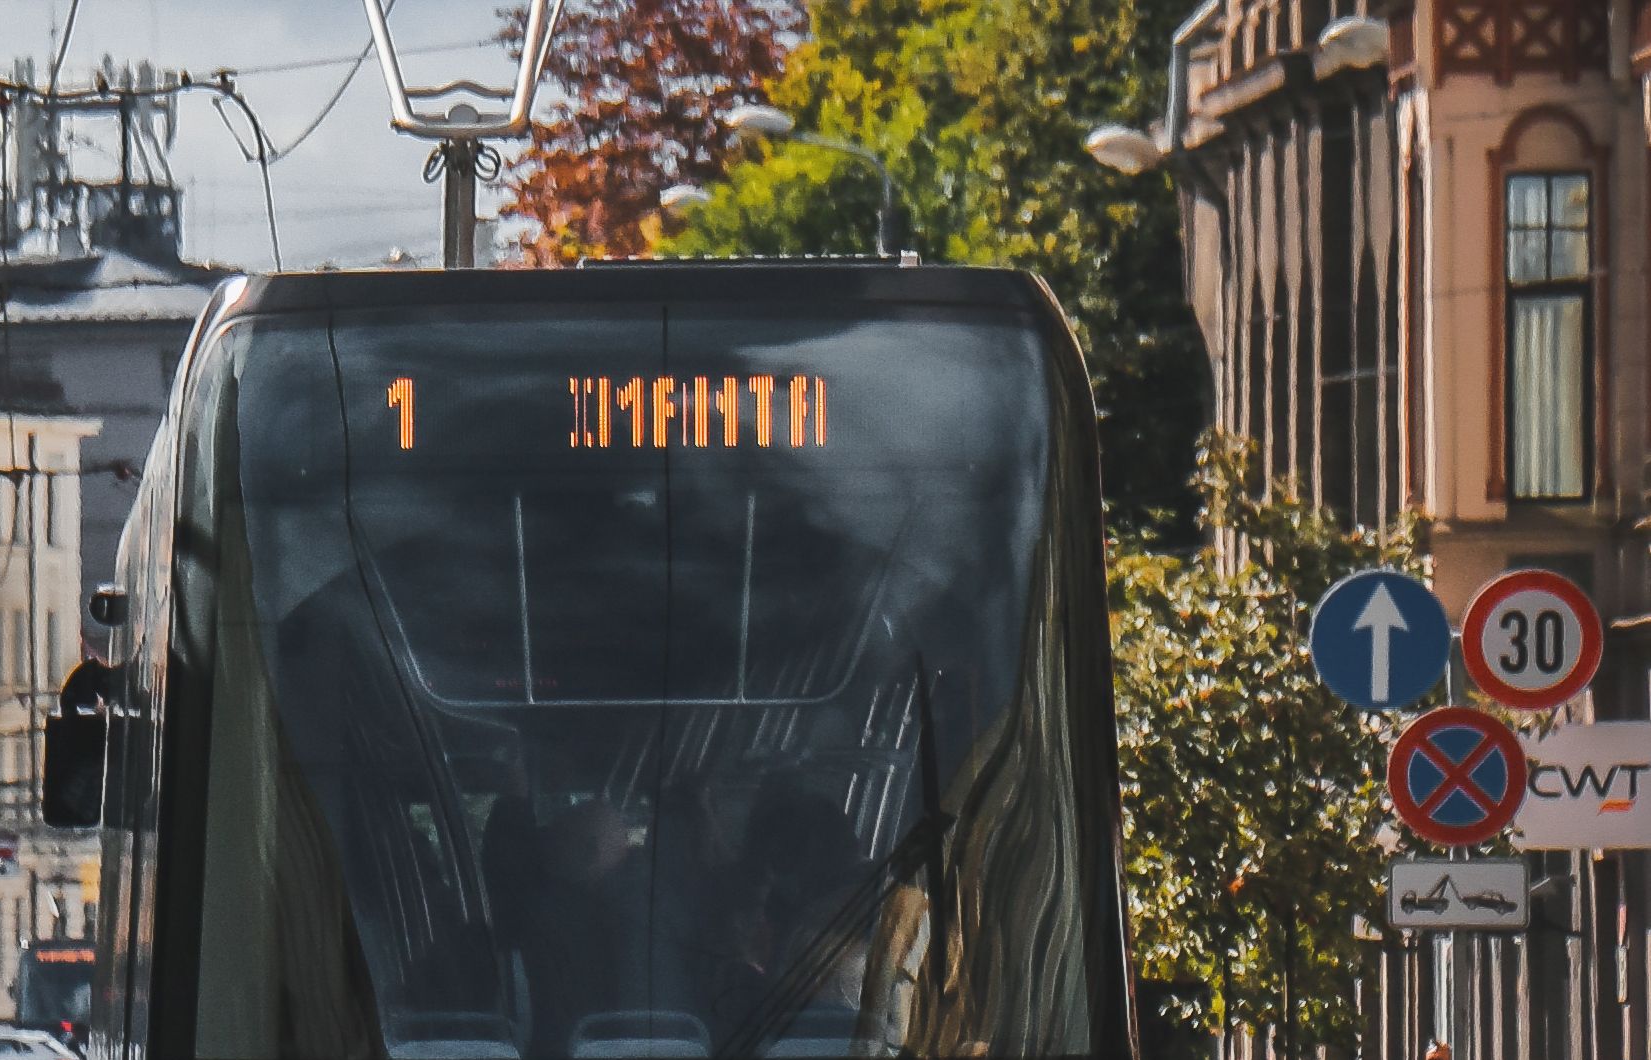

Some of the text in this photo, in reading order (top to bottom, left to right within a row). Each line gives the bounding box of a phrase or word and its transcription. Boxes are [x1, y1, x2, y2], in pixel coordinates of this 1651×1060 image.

[387, 377, 414, 449] 1
[1499, 610, 1565, 675] 30
[1528, 765, 1651, 799] CWT
